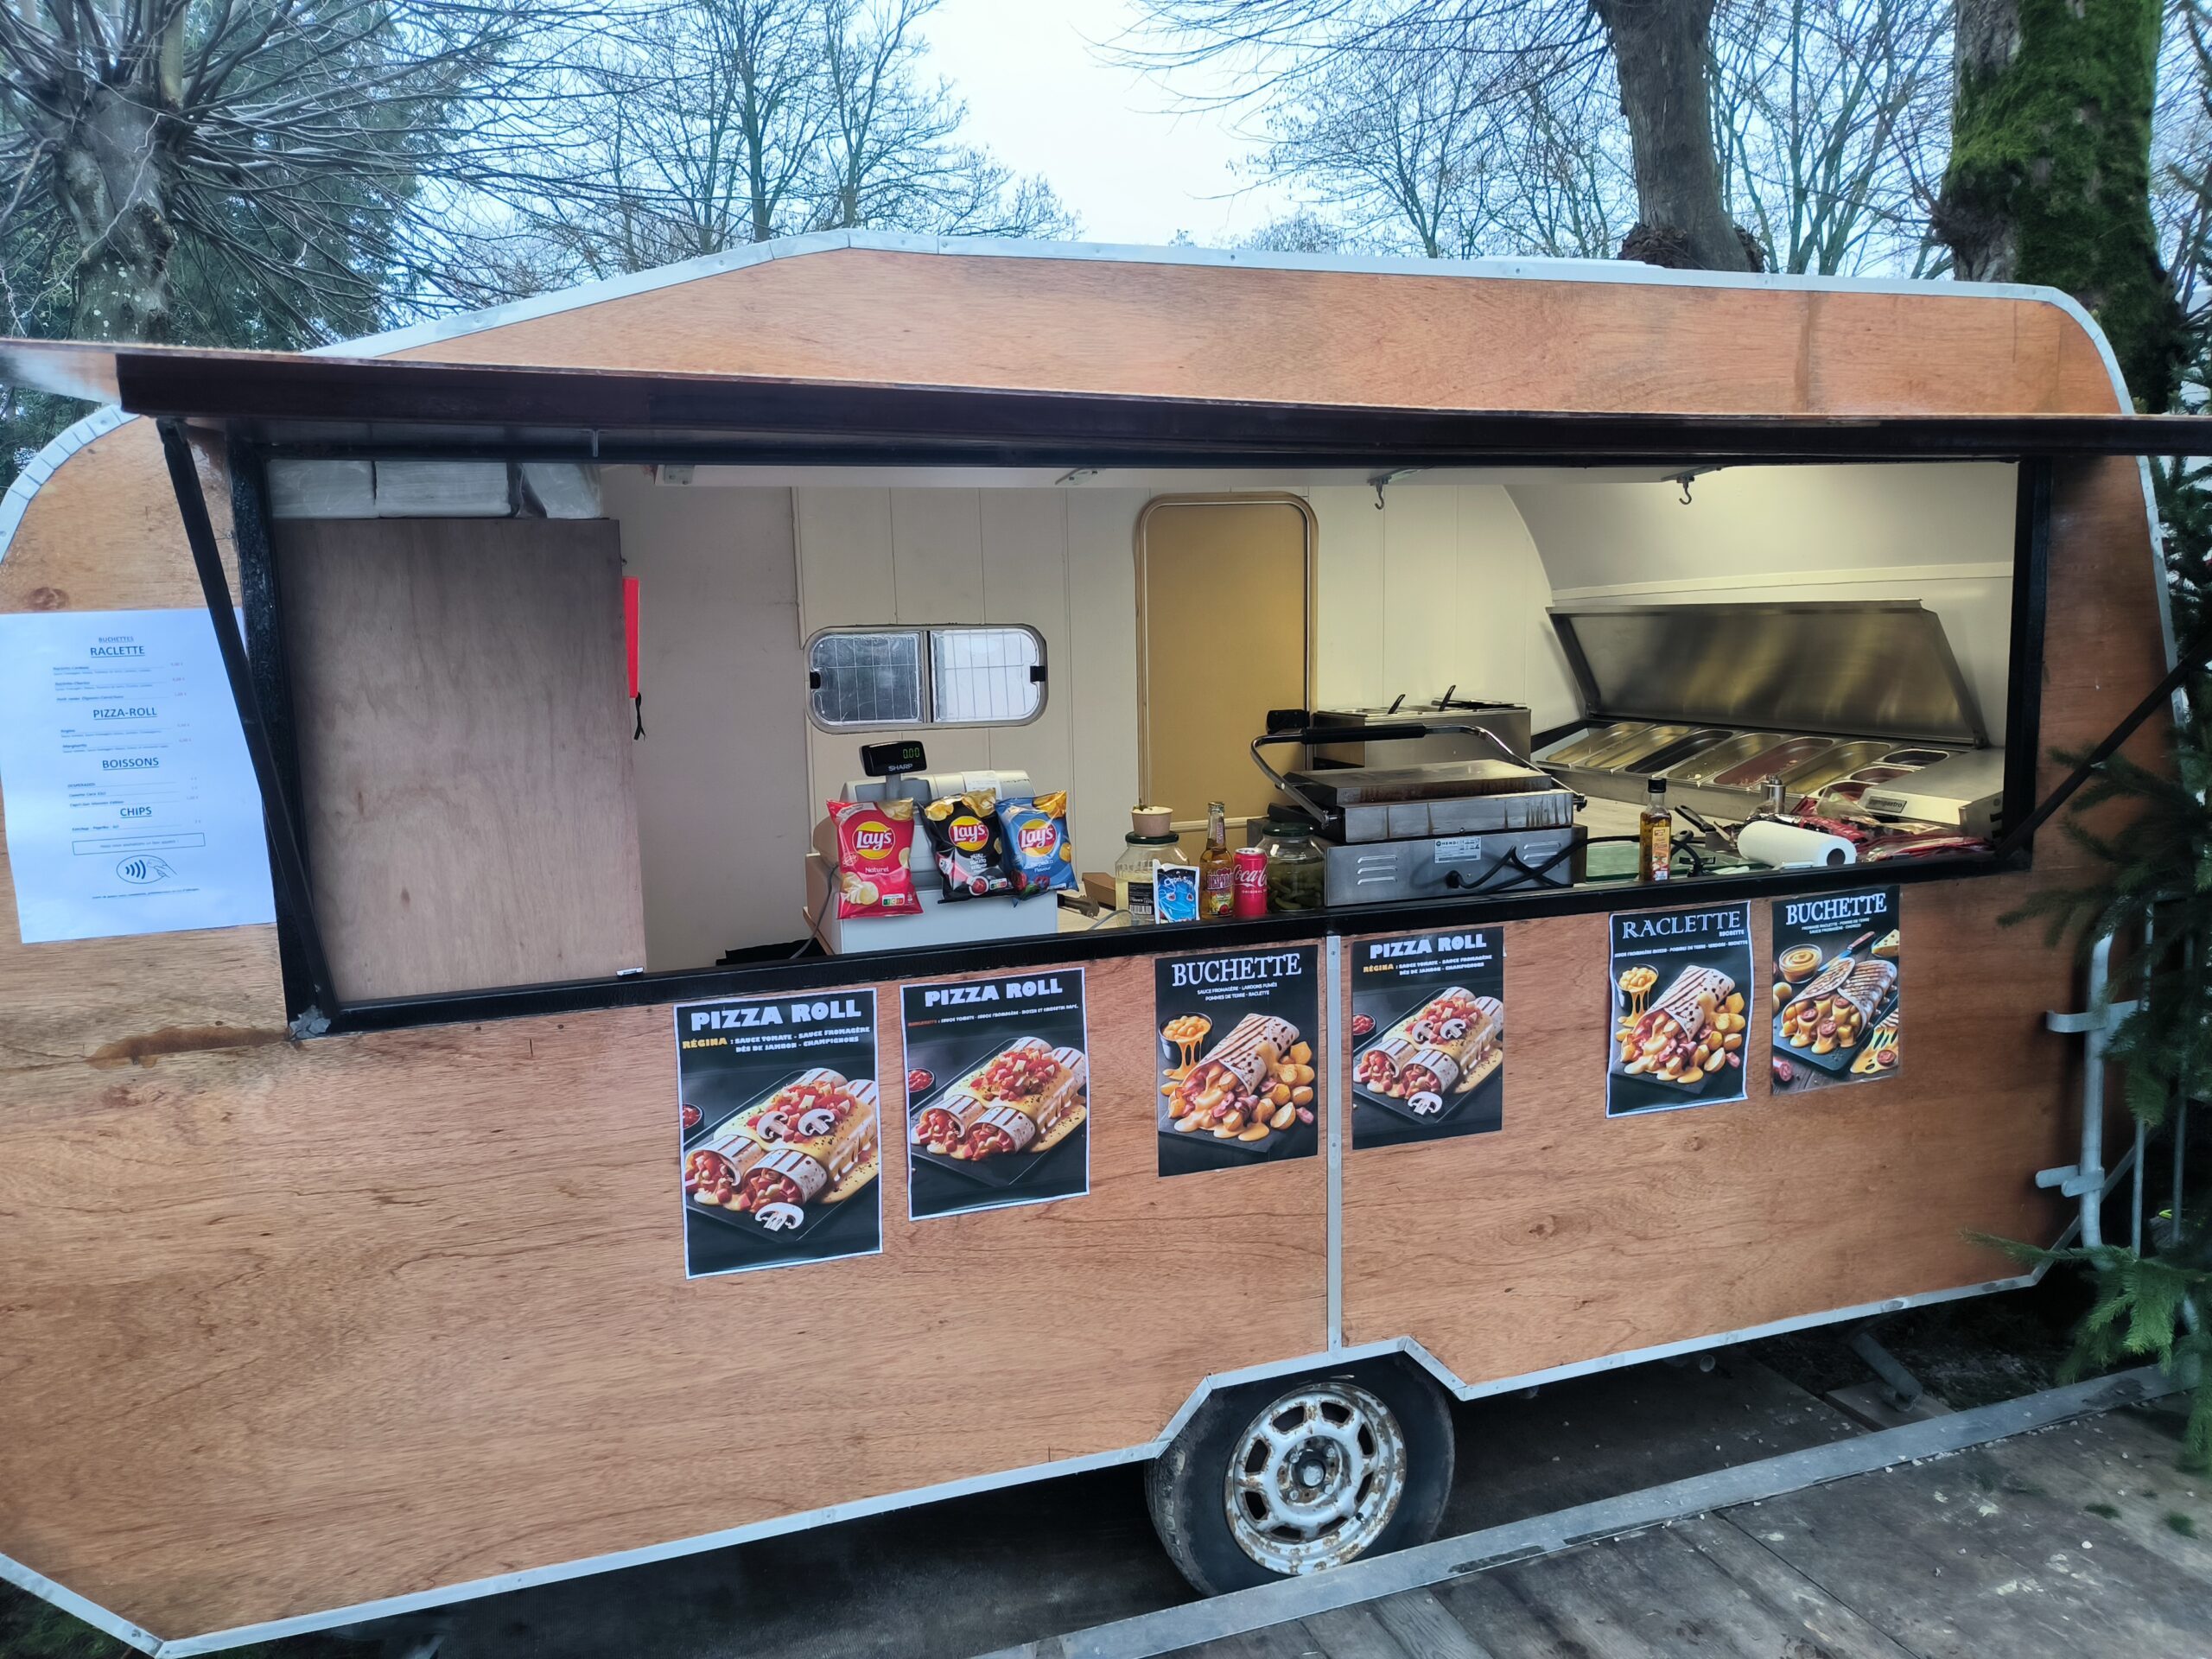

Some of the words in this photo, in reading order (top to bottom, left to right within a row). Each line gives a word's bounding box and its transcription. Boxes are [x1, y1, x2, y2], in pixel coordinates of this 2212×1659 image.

[90, 645, 145, 656] RACLETTE
[93, 707, 157, 718] PIZZA-ROLL
[102, 757, 159, 769] BOISSONS
[888, 763, 913, 772] SHARP
[119, 806, 152, 817] CHIPS
[856, 830, 893, 851] Lay's
[953, 823, 986, 843] Lay's
[1021, 827, 1054, 849] Lay's
[1164, 875, 1193, 887] Capri-Sun
[1785, 893, 1887, 925] BUCHETTE
[1622, 911, 1740, 939] RACLETTE
[1370, 939, 1433, 959] PIZZA
[1438, 933, 1487, 952] ROLL
[1171, 953, 1302, 987] BUCHETTE
[1363, 963, 1394, 973] RÉGINA
[925, 984, 1000, 1007] PIZZA
[1006, 978, 1063, 999] ROLL
[691, 1006, 784, 1032] PIZZA
[791, 999, 861, 1023] ROLL
[682, 1037, 728, 1049] RÉGINA
[798, 1031, 823, 1039] SAUCE
[823, 1027, 870, 1036] FROMAGÈRE
[735, 1045, 751, 1053] DÉS
[765, 1042, 797, 1051] JAMBON
[804, 1036, 859, 1047] CHAMPIGNONS
